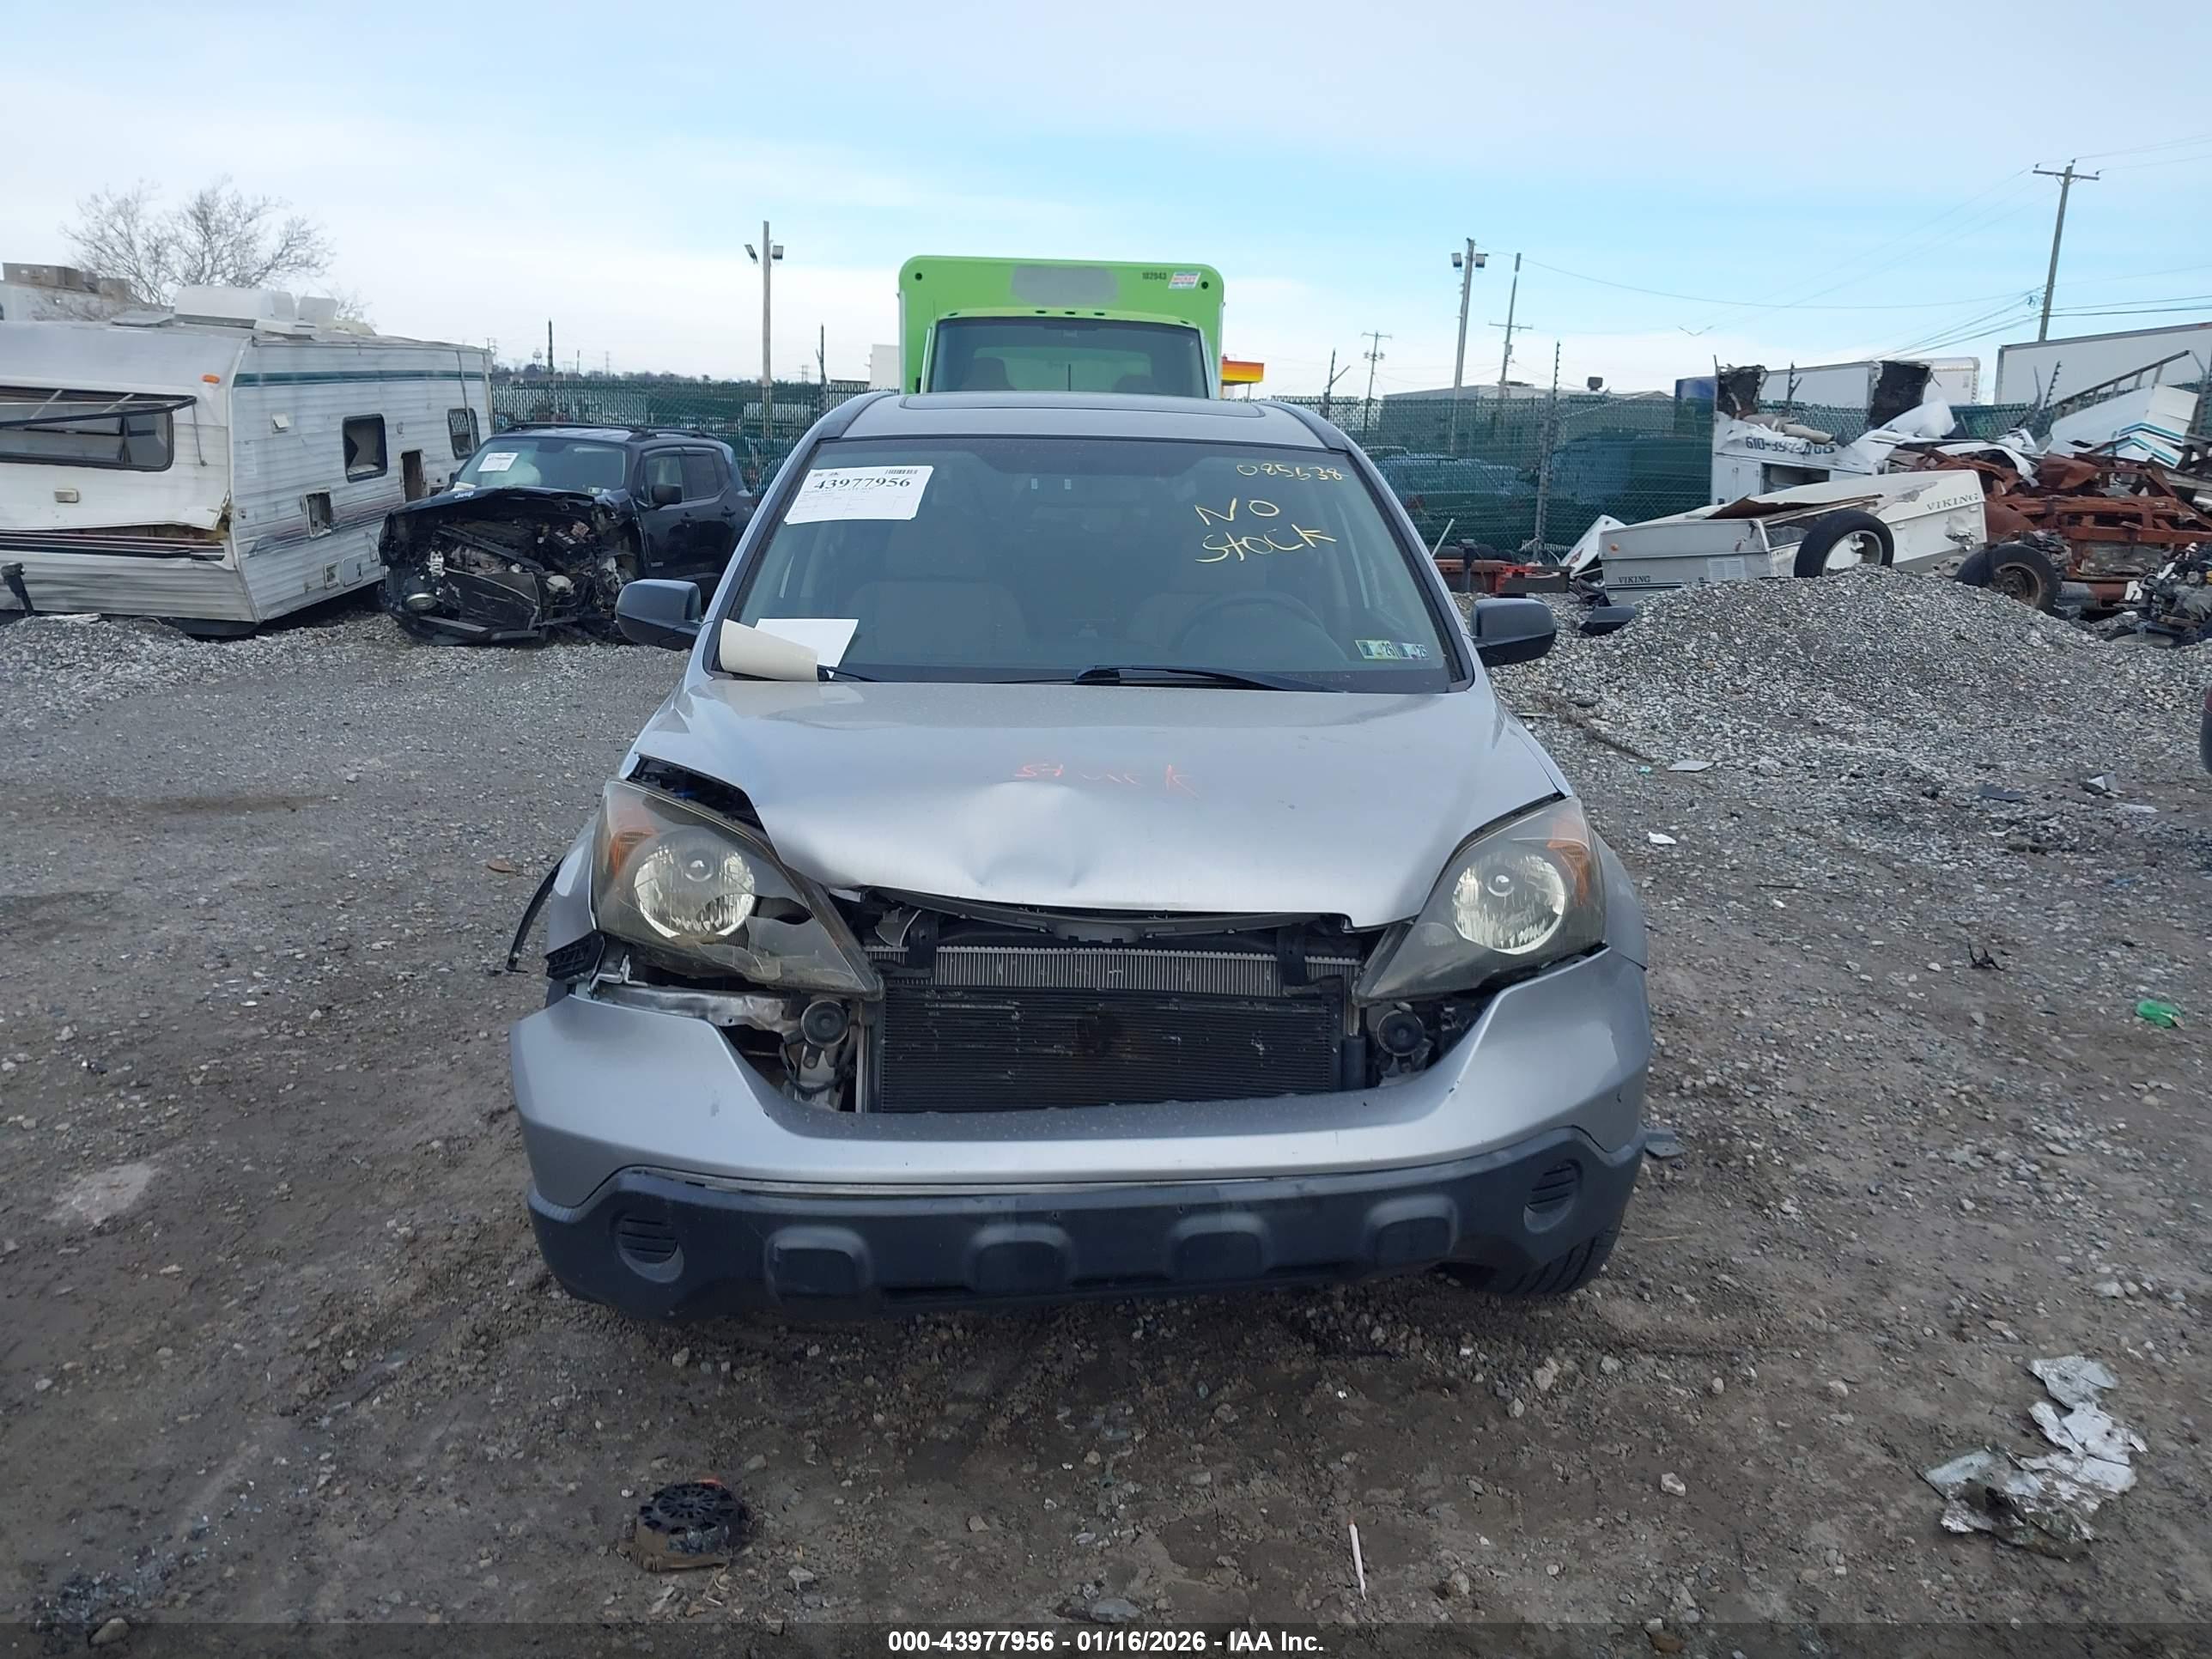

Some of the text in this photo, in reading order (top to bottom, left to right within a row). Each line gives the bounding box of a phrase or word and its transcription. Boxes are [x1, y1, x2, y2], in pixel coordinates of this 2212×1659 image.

[814, 477, 912, 489] 43977956
[1926, 493, 1978, 511] VIKING
[1194, 497, 1280, 526] NO
[1618, 575, 1650, 584] VIKING
